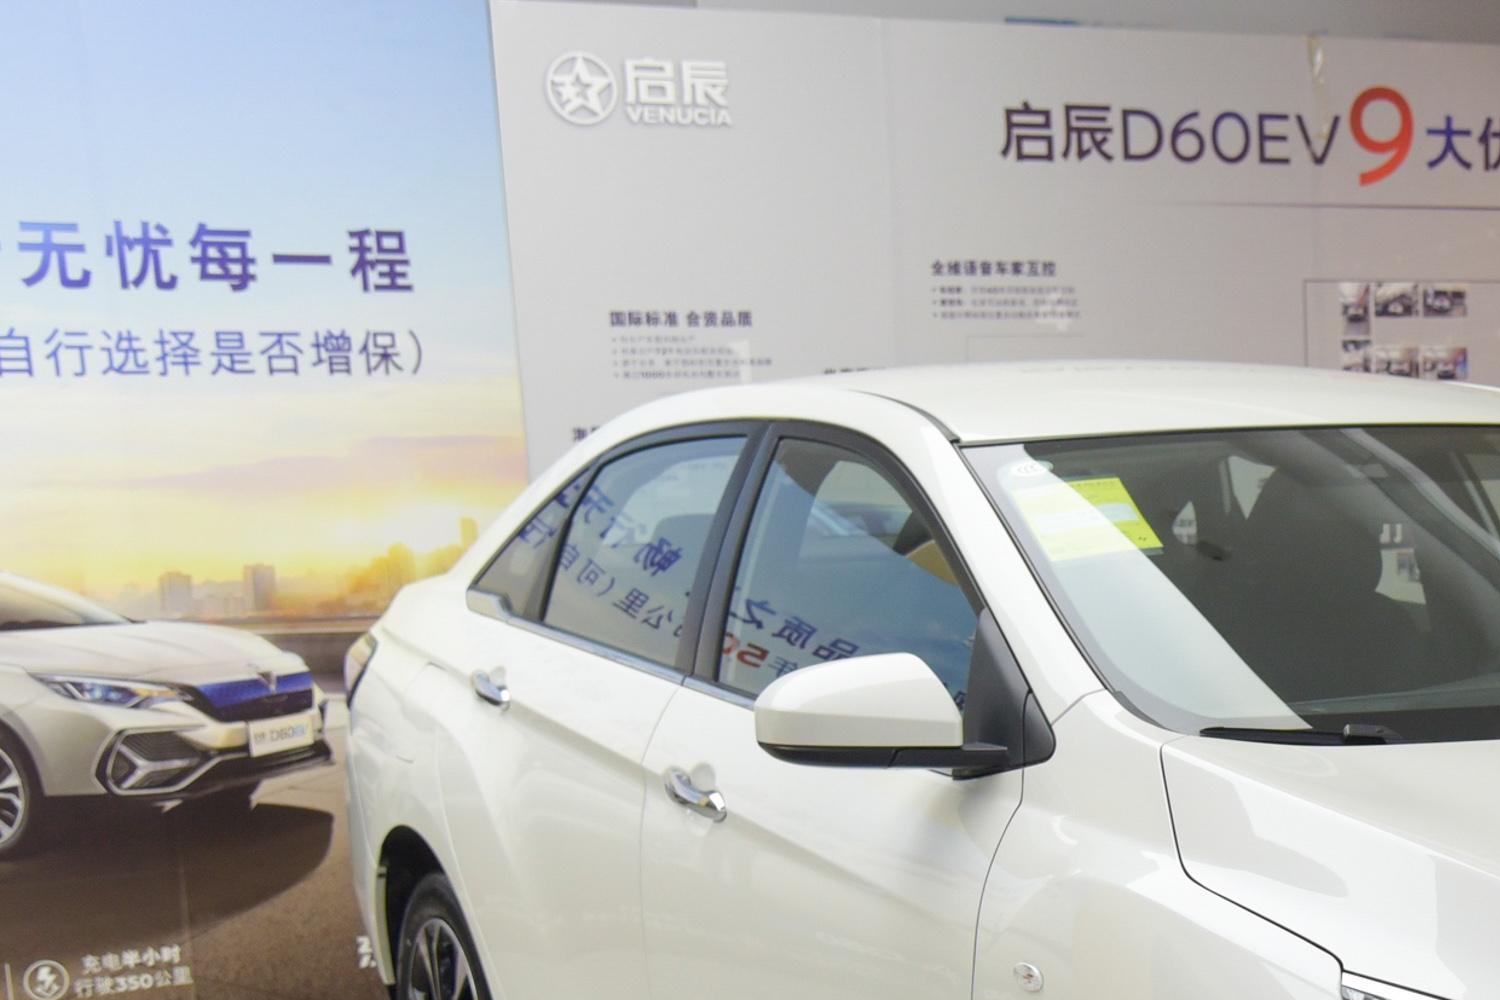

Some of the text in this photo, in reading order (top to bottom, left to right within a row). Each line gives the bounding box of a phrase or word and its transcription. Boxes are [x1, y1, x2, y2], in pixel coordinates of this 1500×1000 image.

[624, 56, 729, 106] 启辰
[625, 105, 732, 127] VENUCIA
[17, 220, 414, 293] 无忧每一程
[609, 310, 753, 328] 国际标准 合资品质
